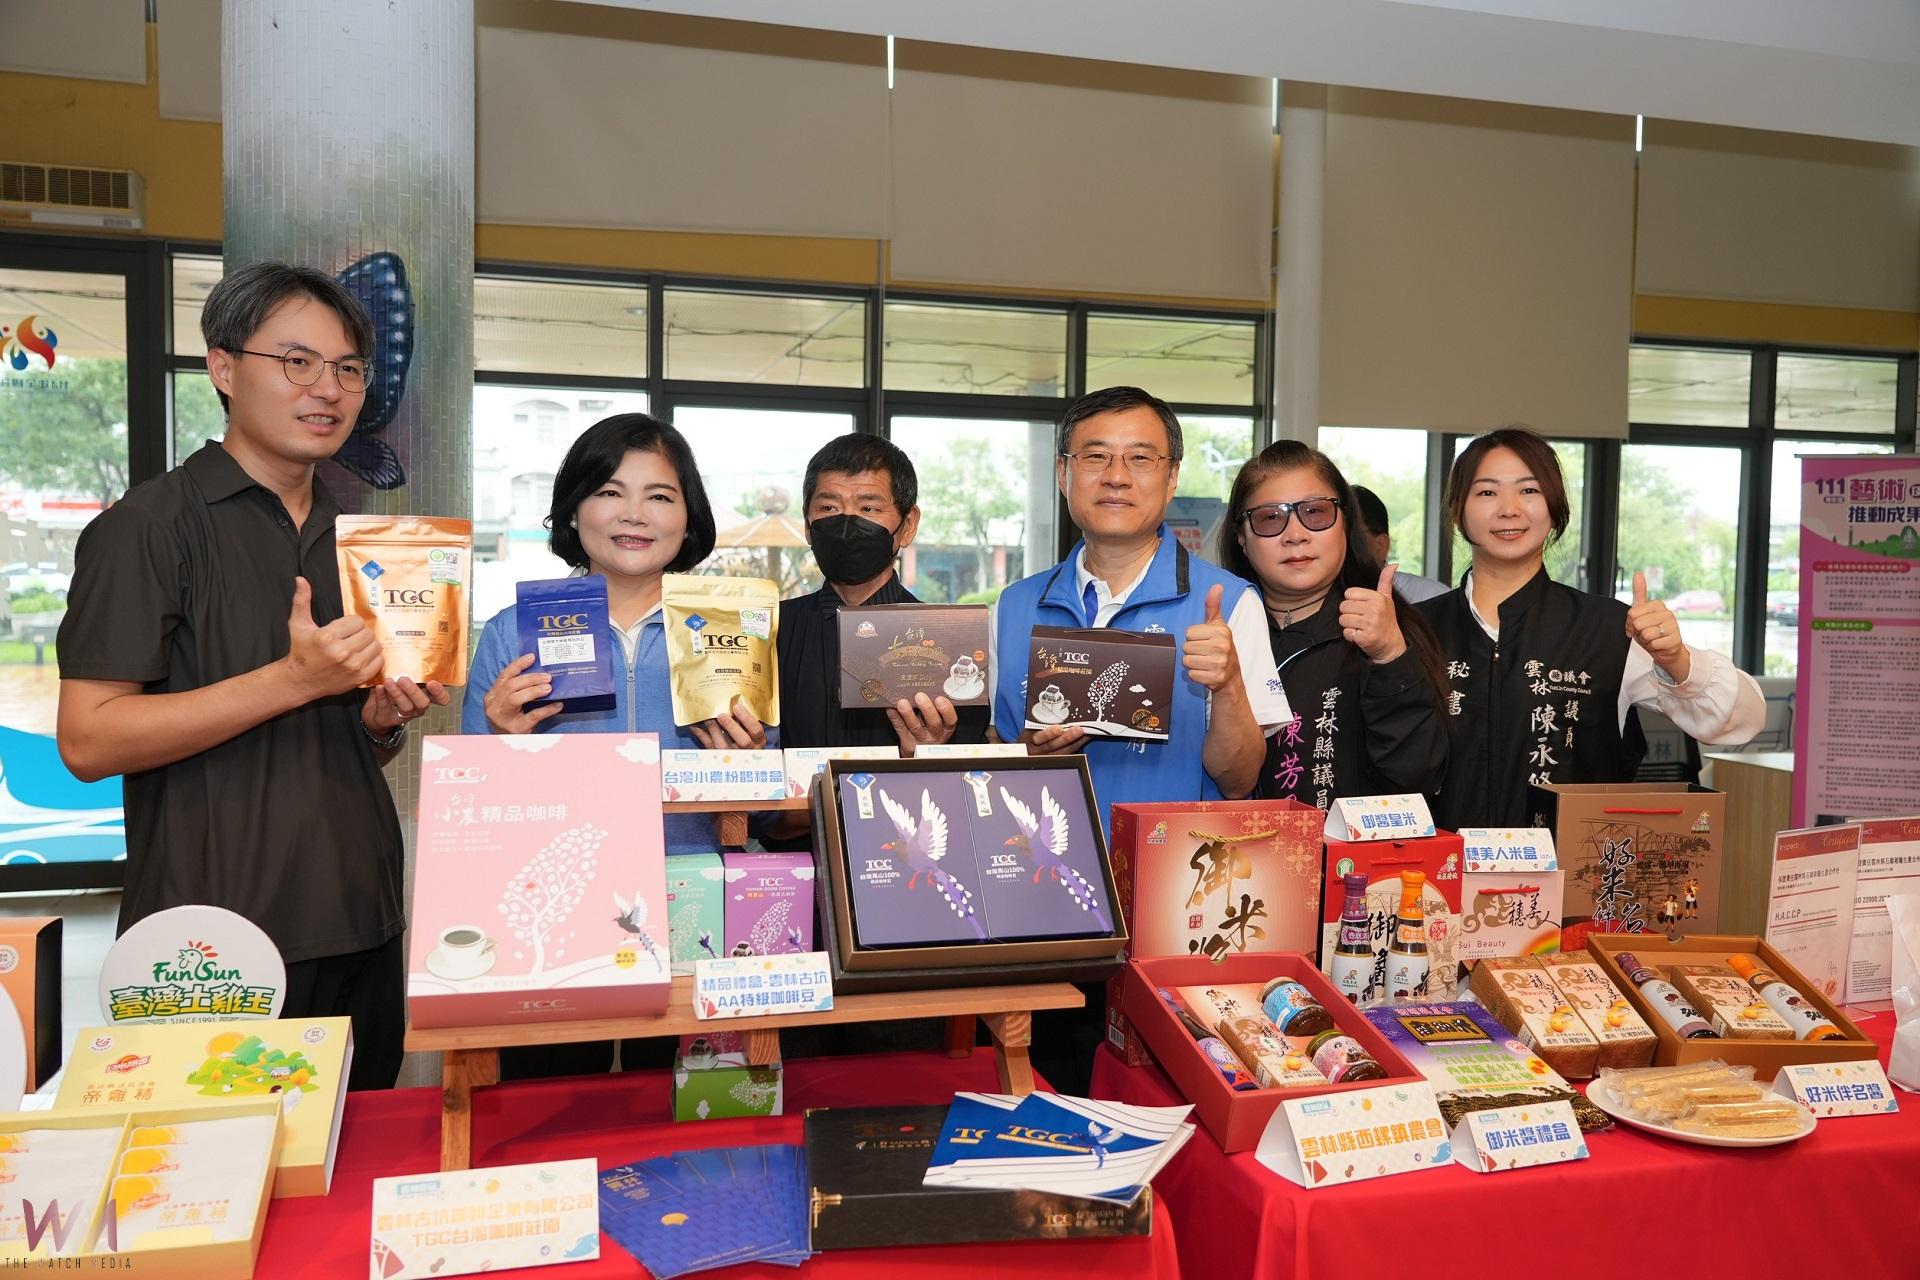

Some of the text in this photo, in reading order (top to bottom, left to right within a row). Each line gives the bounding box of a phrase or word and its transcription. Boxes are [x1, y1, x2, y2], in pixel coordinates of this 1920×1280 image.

[1815, 478, 1845, 494] 111
[1850, 478, 1905, 502] 藝術
[703, 634, 748, 647] TGC
[1446, 660, 1470, 716] 秘書
[1274, 711, 1305, 801] 陳芳
[1311, 686, 1342, 813] 雲林縣議員
[1464, 846, 1538, 861] 穗美人米盒
[110, 983, 276, 1018] 臺灣土雞王
[1805, 1083, 1884, 1103] 好米伴名醬
[1009, 1125, 1072, 1143] TGC
[1300, 1118, 1446, 1158] 雲林縣西螺鎮農會
[1485, 1122, 1572, 1151] 御米醬禮盒
